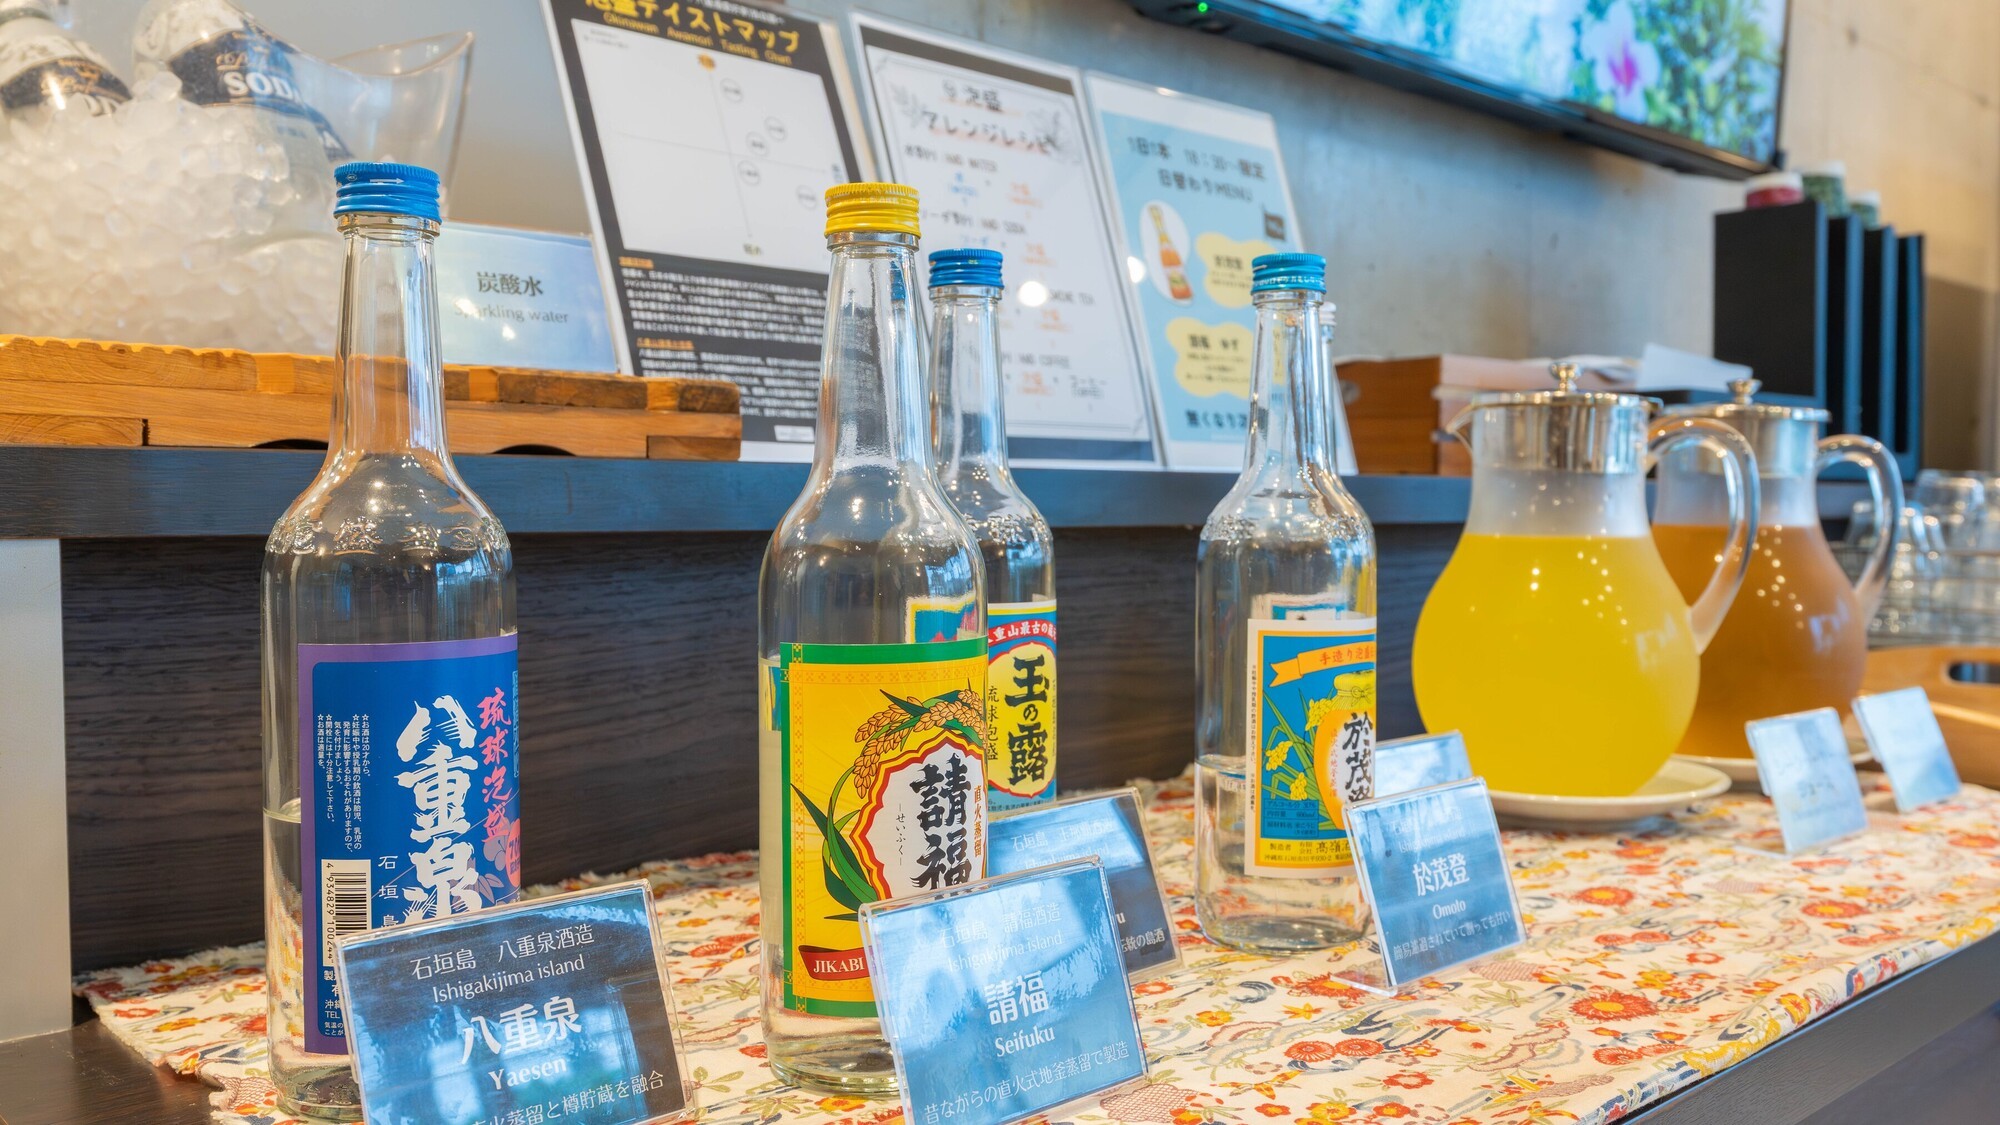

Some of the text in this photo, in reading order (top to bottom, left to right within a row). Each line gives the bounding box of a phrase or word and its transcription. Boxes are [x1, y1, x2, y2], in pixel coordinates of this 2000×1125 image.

[476, 271, 544, 297] 炭酸水
[527, 310, 569, 324] water
[1005, 653, 1050, 786] 玉の露
[477, 687, 512, 843] 琉球泡盛
[393, 694, 482, 922] 八重泉
[909, 752, 973, 889] 請福
[896, 812, 906, 856] せいふく
[326, 876, 335, 916] 934829
[377, 855, 400, 928] 石垣島
[1412, 852, 1471, 897] 於茂登
[1002, 902, 1062, 935] 請福酒造
[1432, 899, 1467, 920] Omoto
[410, 923, 595, 981] 石垣島 八重泉酒造
[1028, 929, 1064, 952] island
[433, 953, 586, 1003] Ishigakijima island
[813, 956, 865, 974] JIKABI
[325, 1010, 340, 1019] TEL
[984, 969, 1050, 1026] 請福
[462, 995, 582, 1065] 八重泉
[994, 1026, 1056, 1058] Seifuku
[488, 1057, 567, 1090] Yaesen
[925, 1040, 1130, 1125] 昔ながらの直火式地釜蒸留で製造
